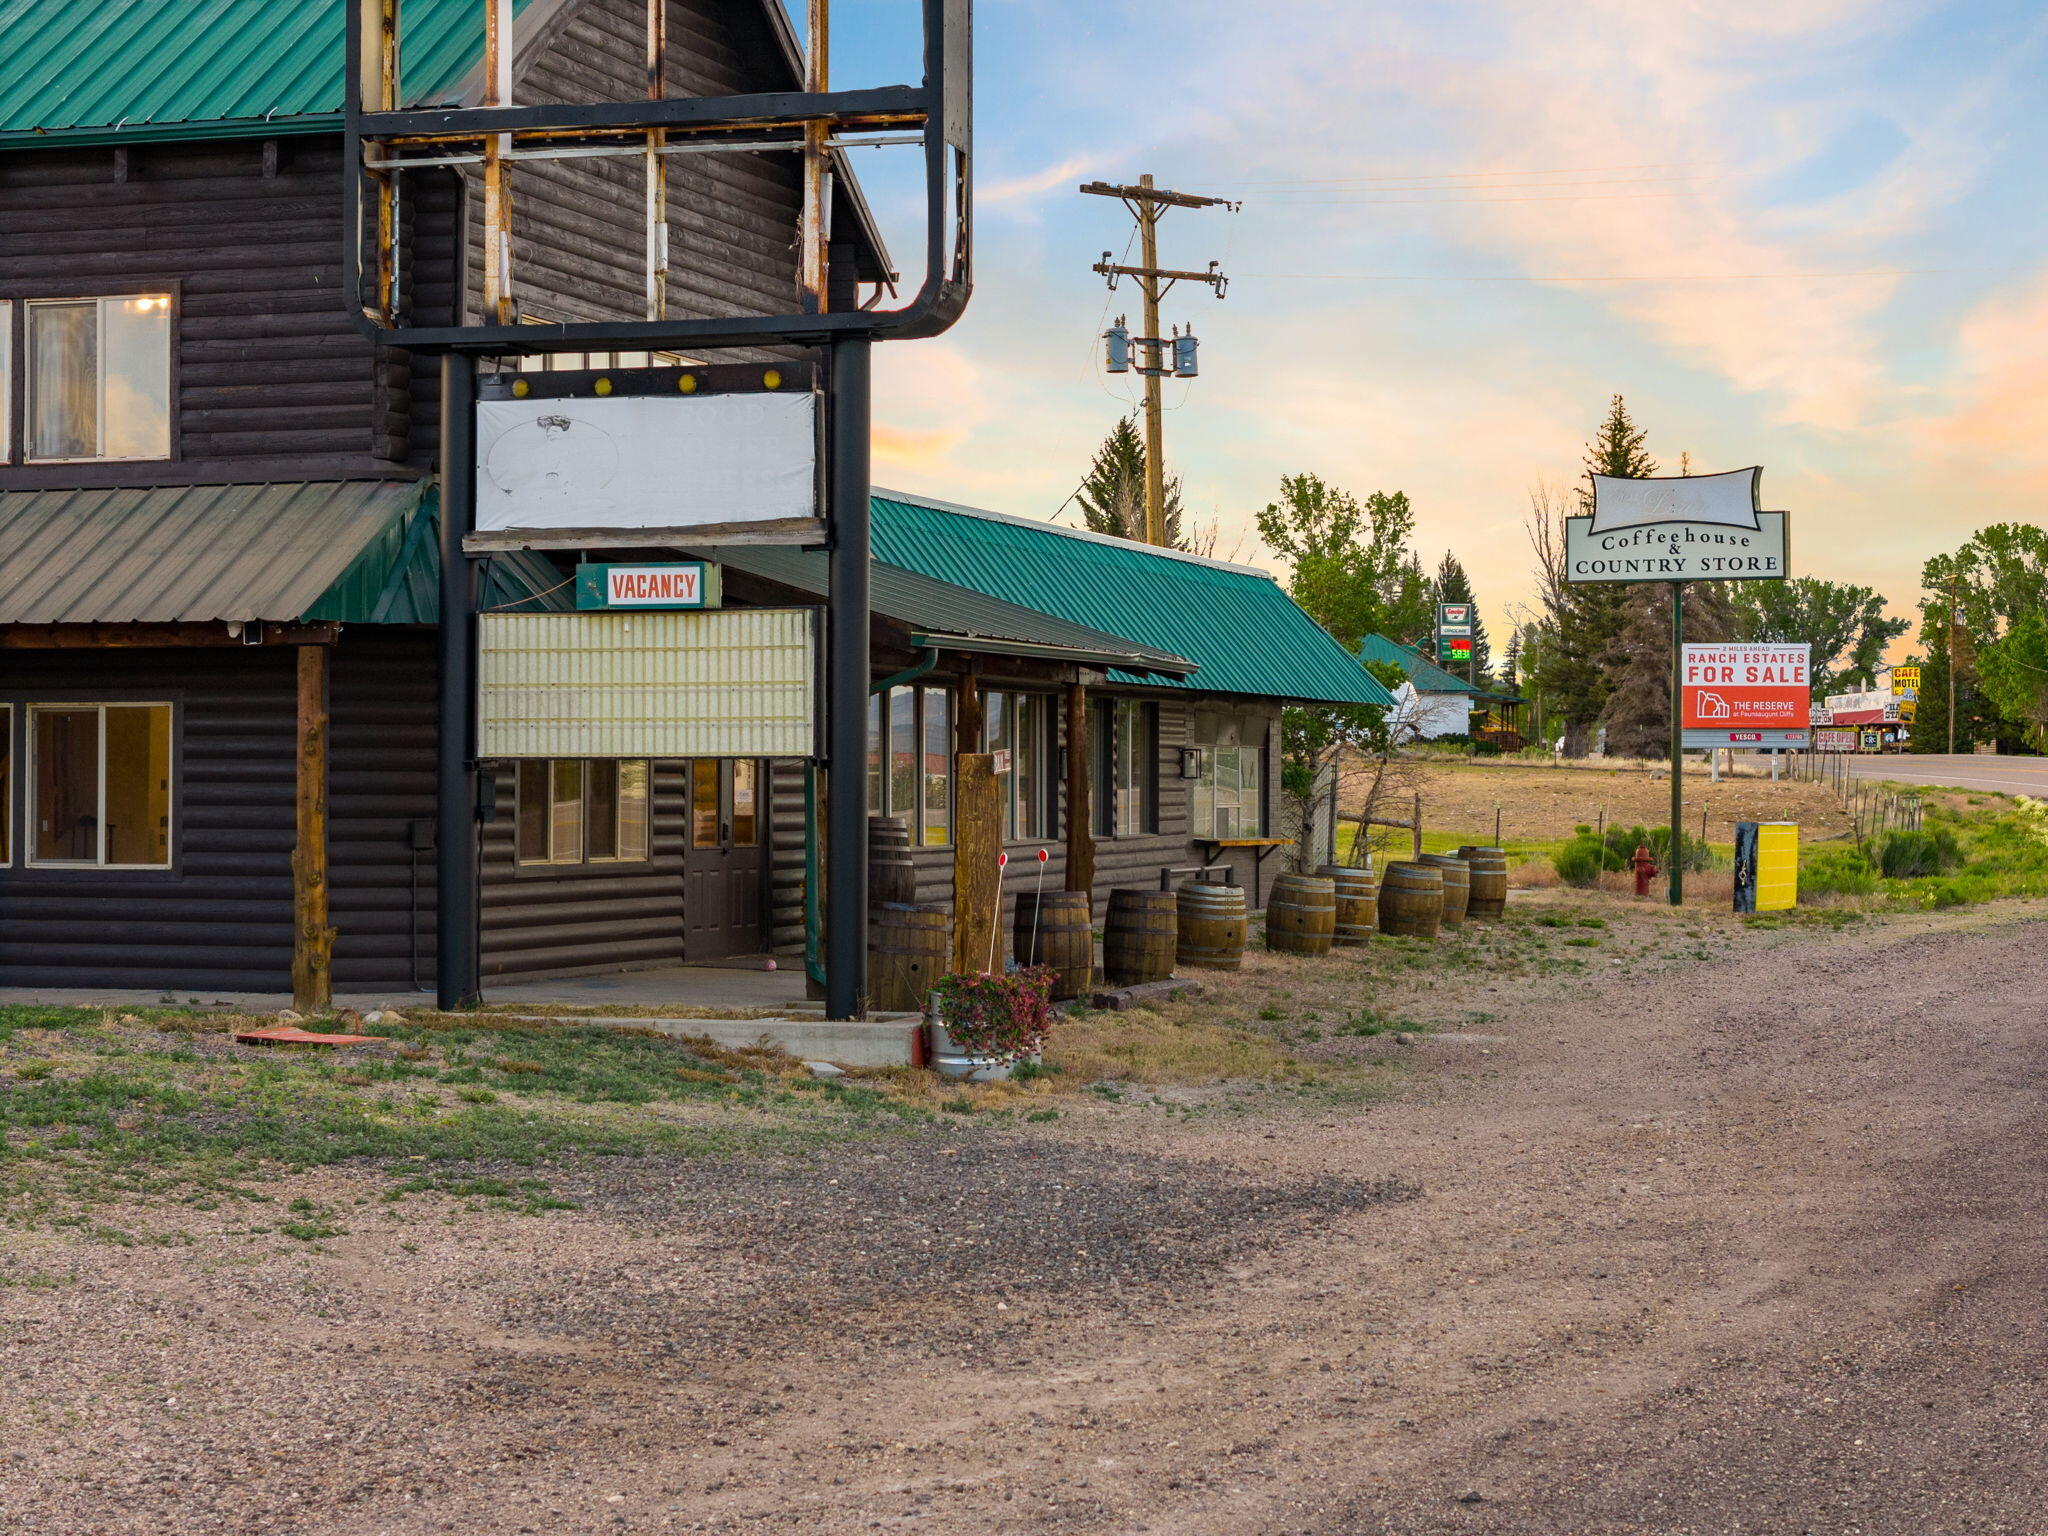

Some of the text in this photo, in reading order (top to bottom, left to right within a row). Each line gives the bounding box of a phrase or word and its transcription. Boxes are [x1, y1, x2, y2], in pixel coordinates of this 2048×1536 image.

[1602, 528, 1750, 551] Coffeehouse
[1669, 543, 1681, 555] &
[1576, 556, 1777, 574] COUNTRY STORE
[612, 574, 695, 598] VACANCY
[1688, 653, 1805, 664] RANCH ESTATES
[1688, 666, 1805, 683] FOR SALE
[1894, 668, 1919, 678] CAFE
[1894, 679, 1919, 688] MOTEL
[1733, 701, 1794, 711] THE RESERVE
[1818, 732, 1835, 743] CAFE
